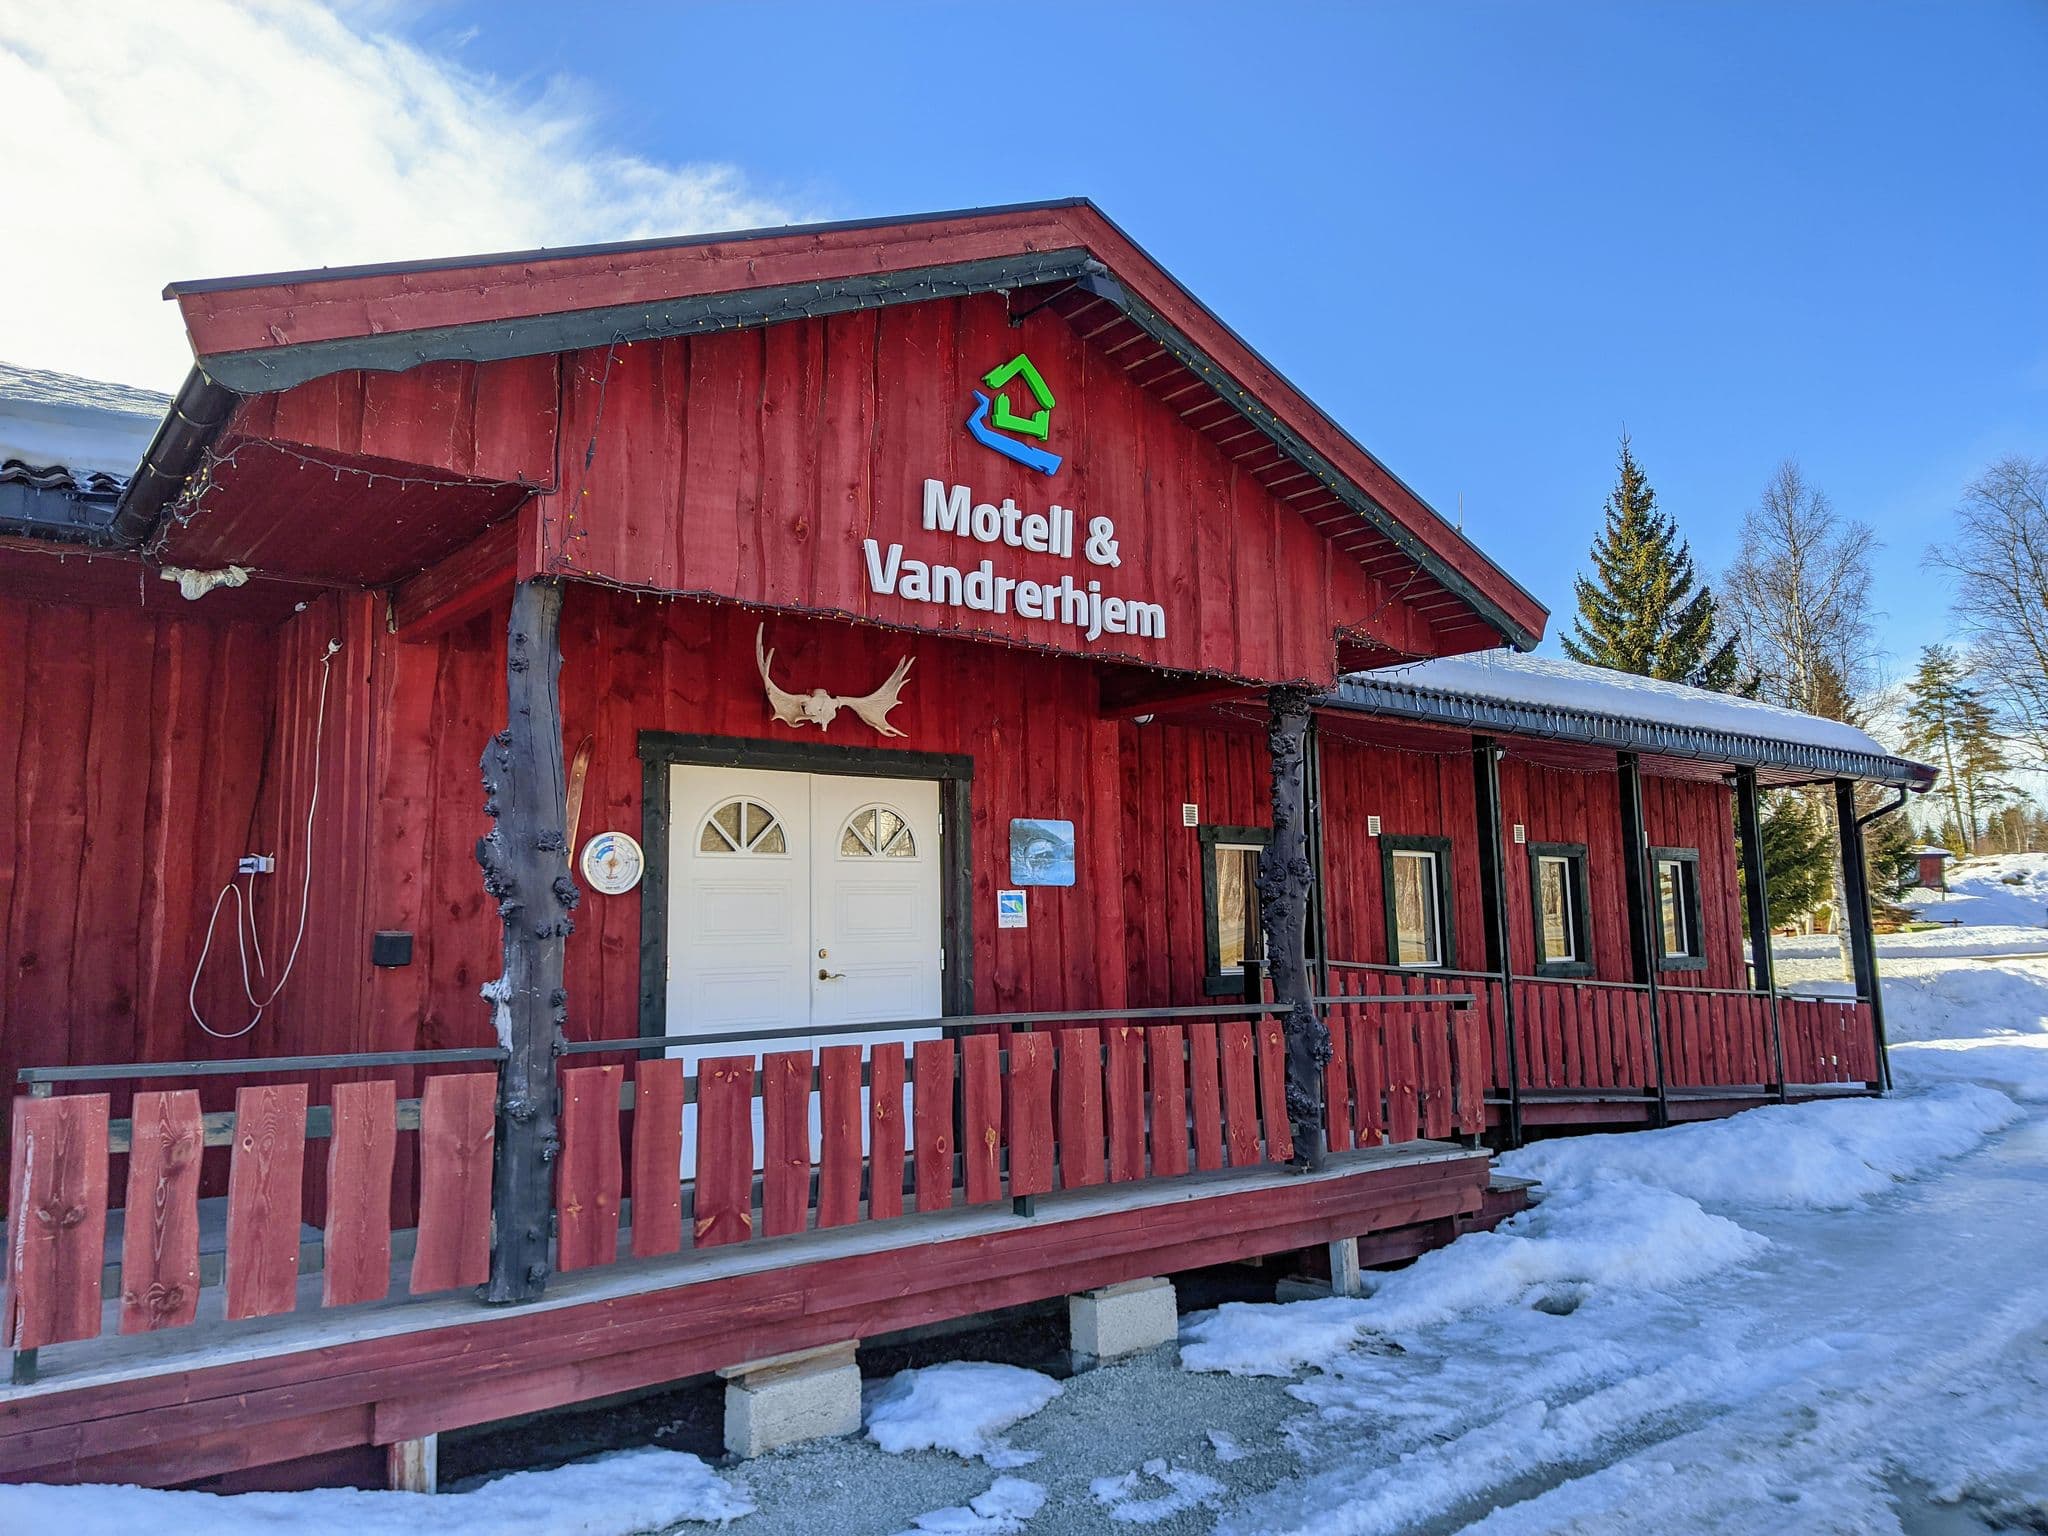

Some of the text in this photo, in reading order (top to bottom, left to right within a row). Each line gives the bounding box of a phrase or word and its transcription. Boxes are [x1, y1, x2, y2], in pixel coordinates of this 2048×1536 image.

[923, 478, 1121, 567] Motell &
[863, 539, 1166, 641] Vandrerhjem
